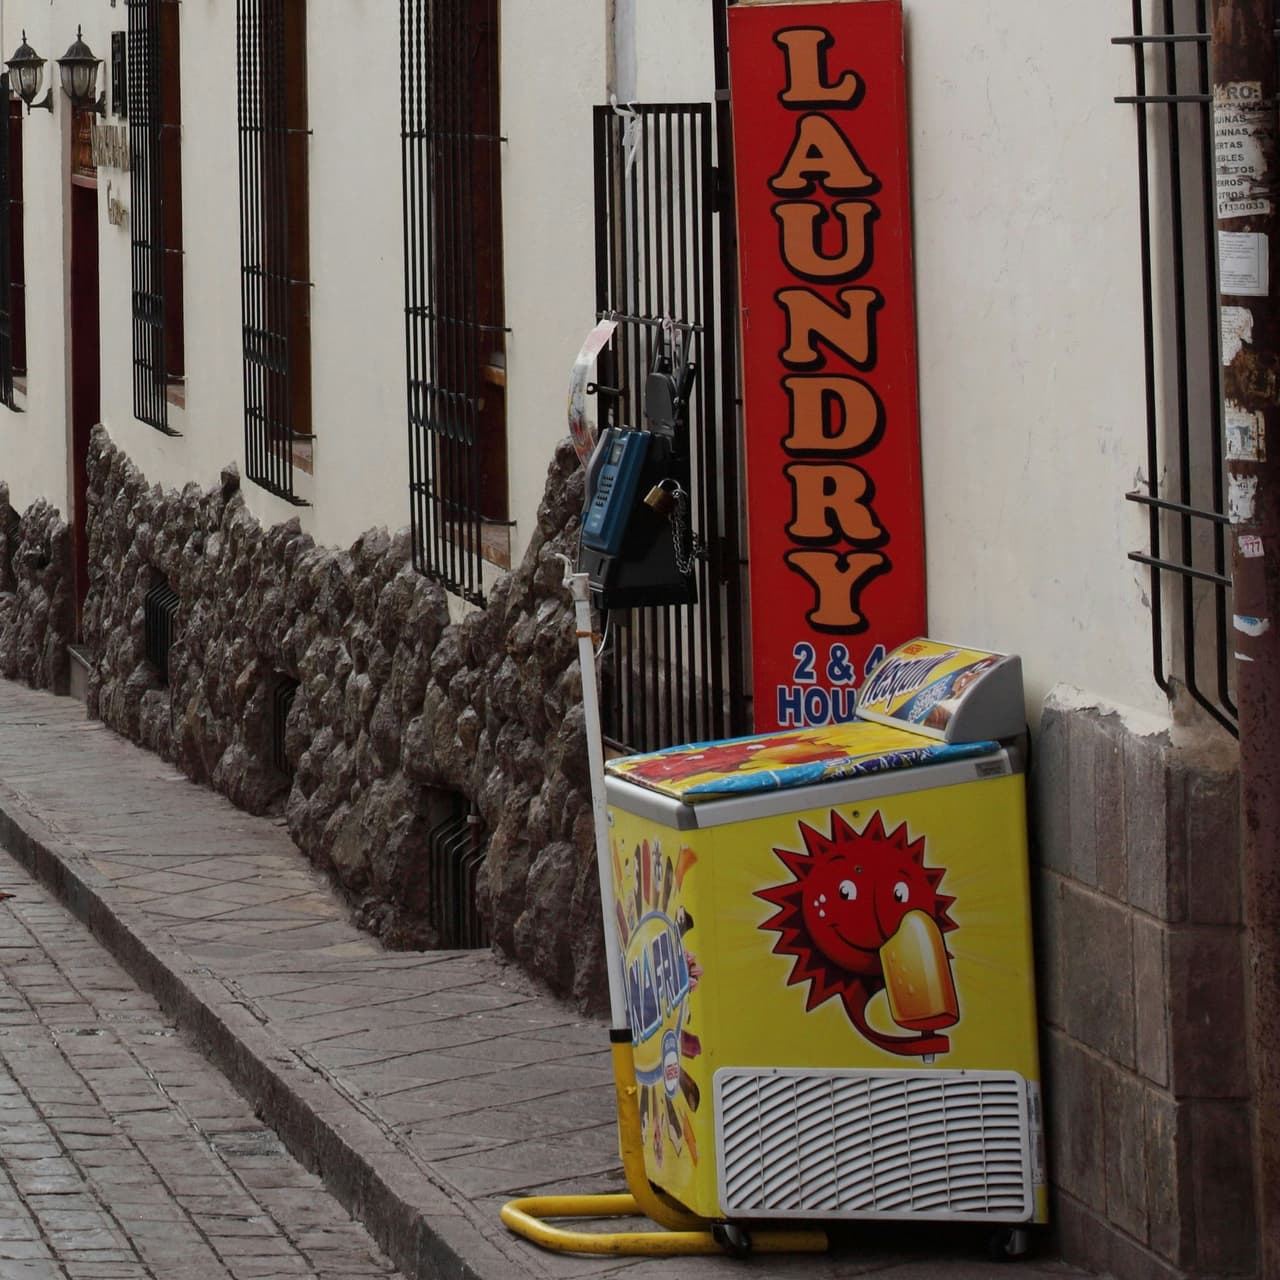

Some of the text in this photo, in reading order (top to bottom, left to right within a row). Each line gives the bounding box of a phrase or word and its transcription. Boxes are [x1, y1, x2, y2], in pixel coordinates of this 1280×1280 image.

[768, 25, 893, 635] LAUNDRY
[793, 641, 817, 681] 2
[827, 642, 856, 682] &
[777, 685, 857, 726] HOU
